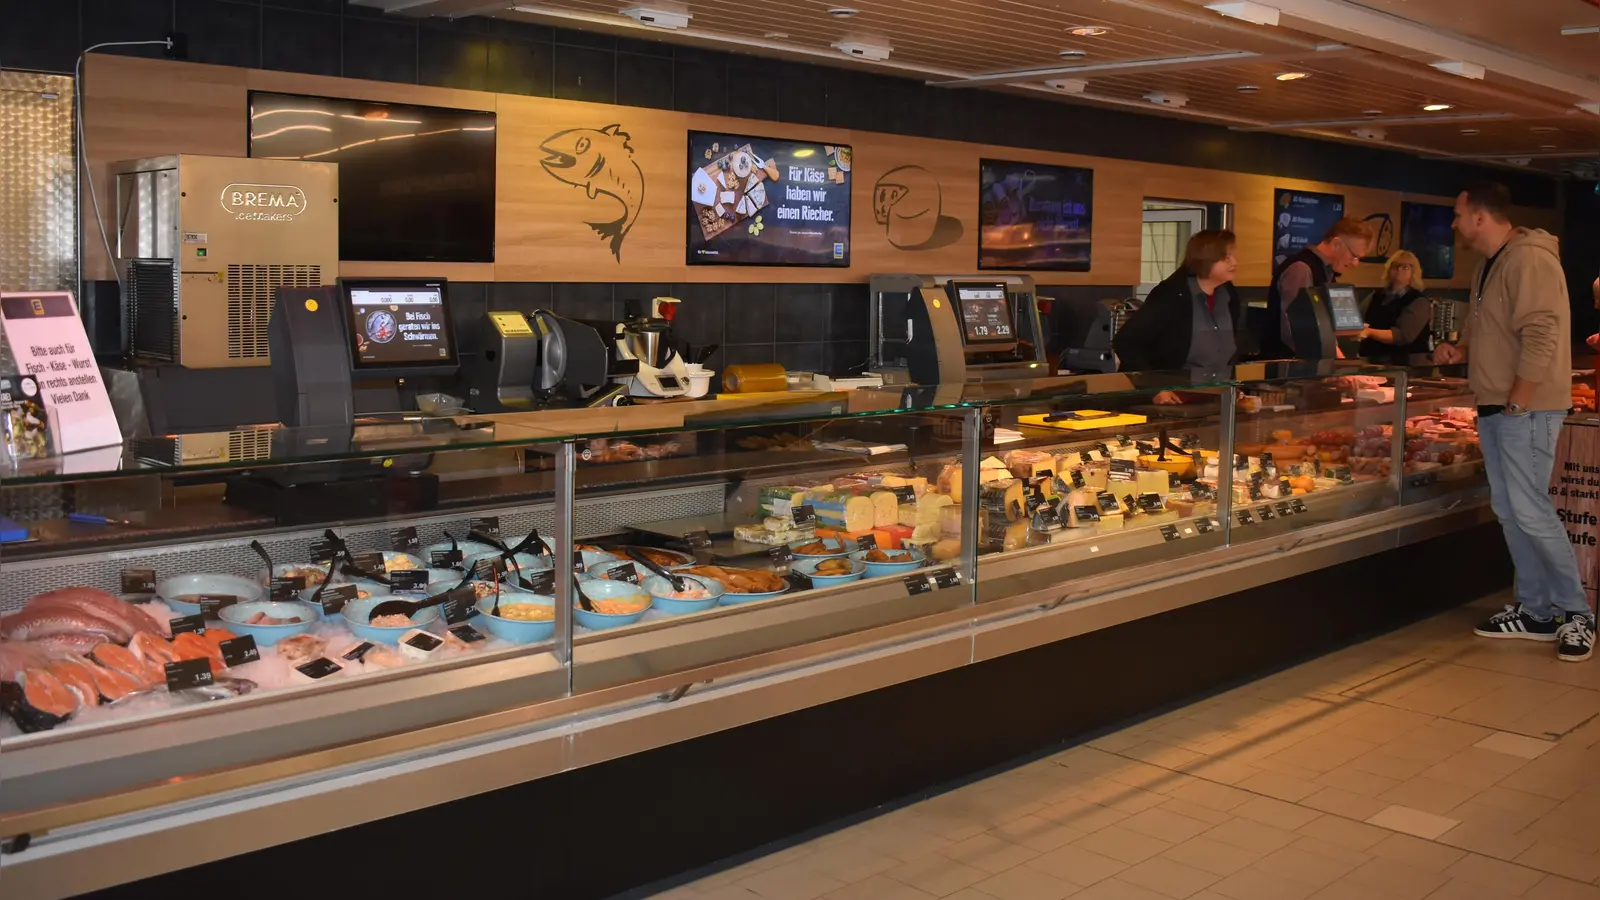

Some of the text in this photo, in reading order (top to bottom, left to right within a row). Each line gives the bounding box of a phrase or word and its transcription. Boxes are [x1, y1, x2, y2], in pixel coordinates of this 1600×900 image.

[789, 166, 825, 183] Für Käse
[232, 191, 299, 208] BREMA
[786, 185, 827, 202] haben wir
[777, 204, 834, 222] einen Riecher.
[405, 312, 431, 320] Bei Fisch
[398, 322, 441, 332] geraten wir ins
[974, 326, 988, 335] 1.79
[30, 343, 75, 356] Bitte auch für
[26, 362, 46, 373] Fisch
[50, 360, 67, 371] Käse
[72, 358, 92, 369] Wurst
[46, 377, 68, 388] rechts
[68, 374, 97, 386] anstellen
[51, 390, 91, 404] Vielen Dank
[1564, 461, 1600, 474] Mit uns
[1560, 475, 1600, 486] wirst du
[1560, 487, 1567, 496] &
[1570, 489, 1600, 500] stark!
[1557, 508, 1598, 525] Stufe
